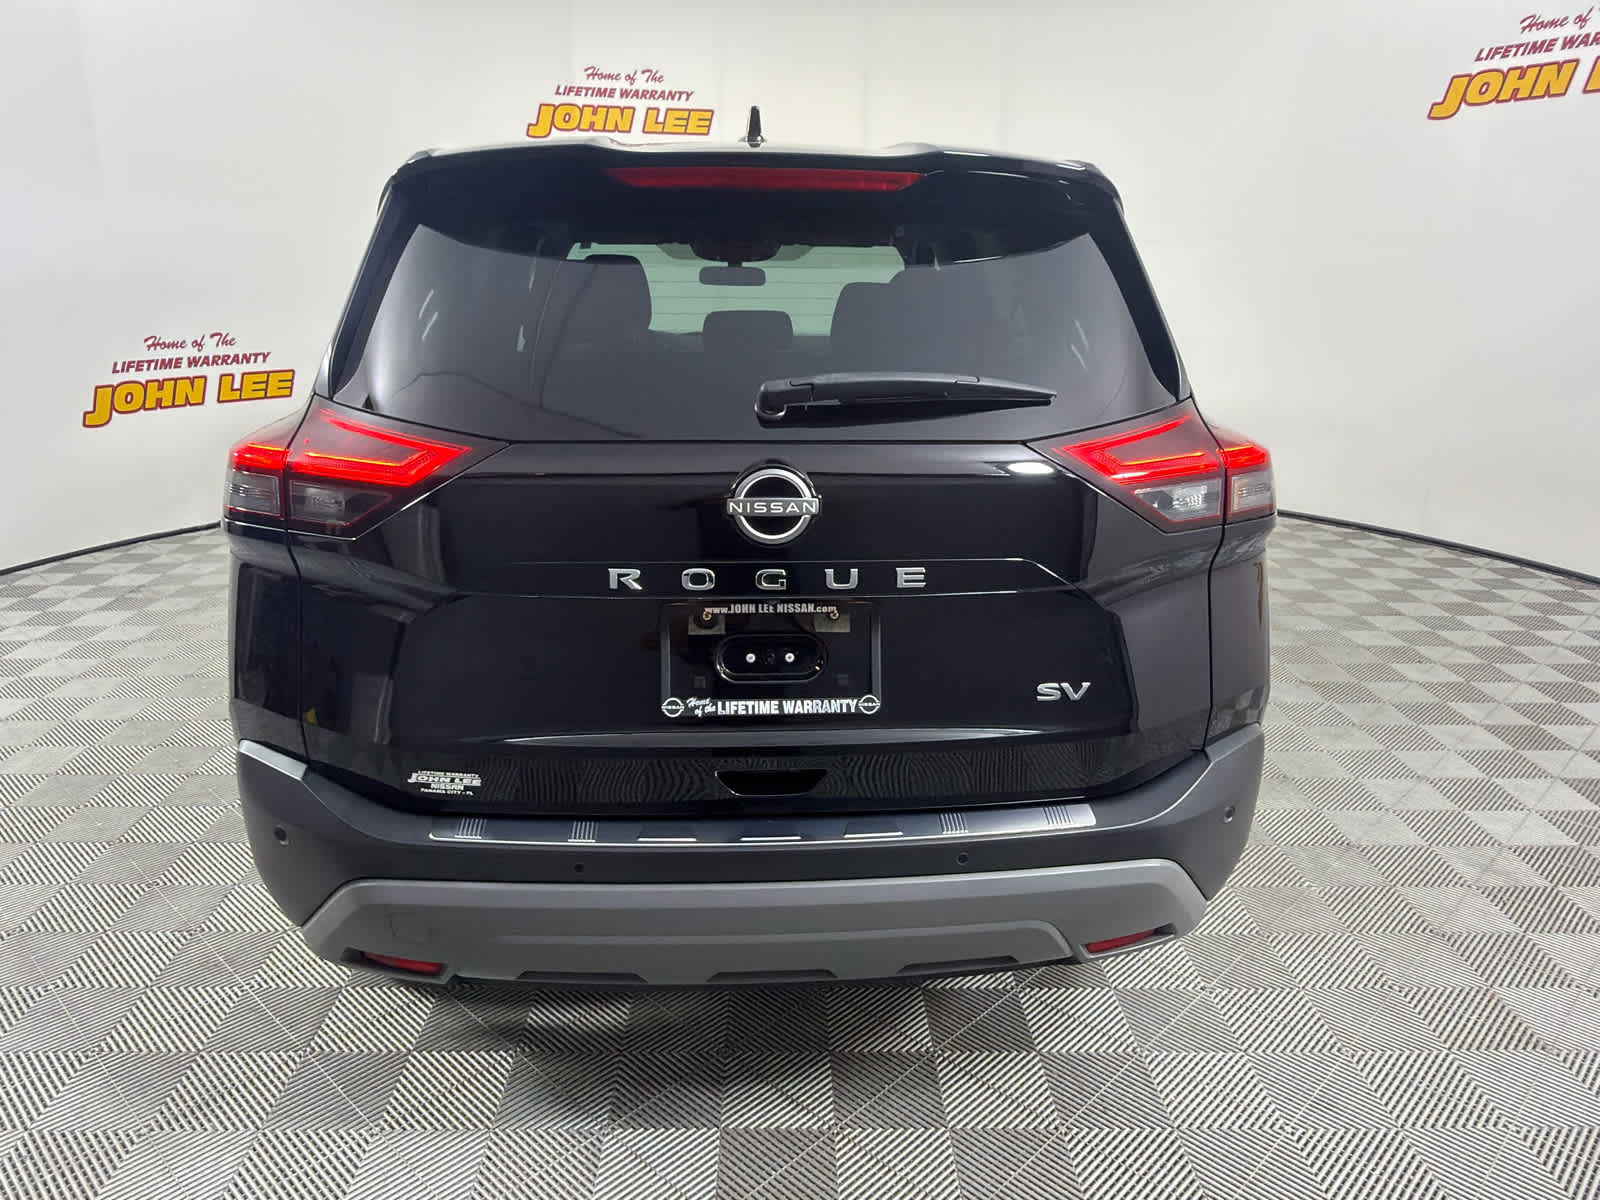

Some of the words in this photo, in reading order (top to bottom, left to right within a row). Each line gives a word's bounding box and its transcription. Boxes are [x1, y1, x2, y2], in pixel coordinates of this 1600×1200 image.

[1520, 14, 1569, 34] Home
[1573, 6, 1594, 30] of
[1474, 38, 1559, 62] LIFETIME
[584, 65, 621, 82] Home
[624, 69, 637, 85] of
[641, 69, 664, 83] The
[554, 85, 617, 98] LIFETIME
[619, 89, 694, 101] WARRANTY
[1427, 58, 1580, 120] JOHN
[526, 103, 636, 138] JOHN
[642, 107, 714, 135] LEE
[143, 335, 187, 351] Home
[191, 334, 206, 352] of
[209, 332, 236, 347] The
[112, 357, 183, 374] LIFETIME
[187, 352, 271, 368] WARRANTY
[82, 375, 207, 428] JOHN
[217, 369, 295, 403] LEE
[729, 502, 817, 513] NISSAN
[608, 567, 927, 590] ROGUE
[1036, 682, 1091, 701] SV
[717, 701, 779, 715] LIFETIME
[782, 699, 858, 713] WARRANTY
[408, 773, 451, 783] JOHN
[454, 778, 482, 786] LEE
